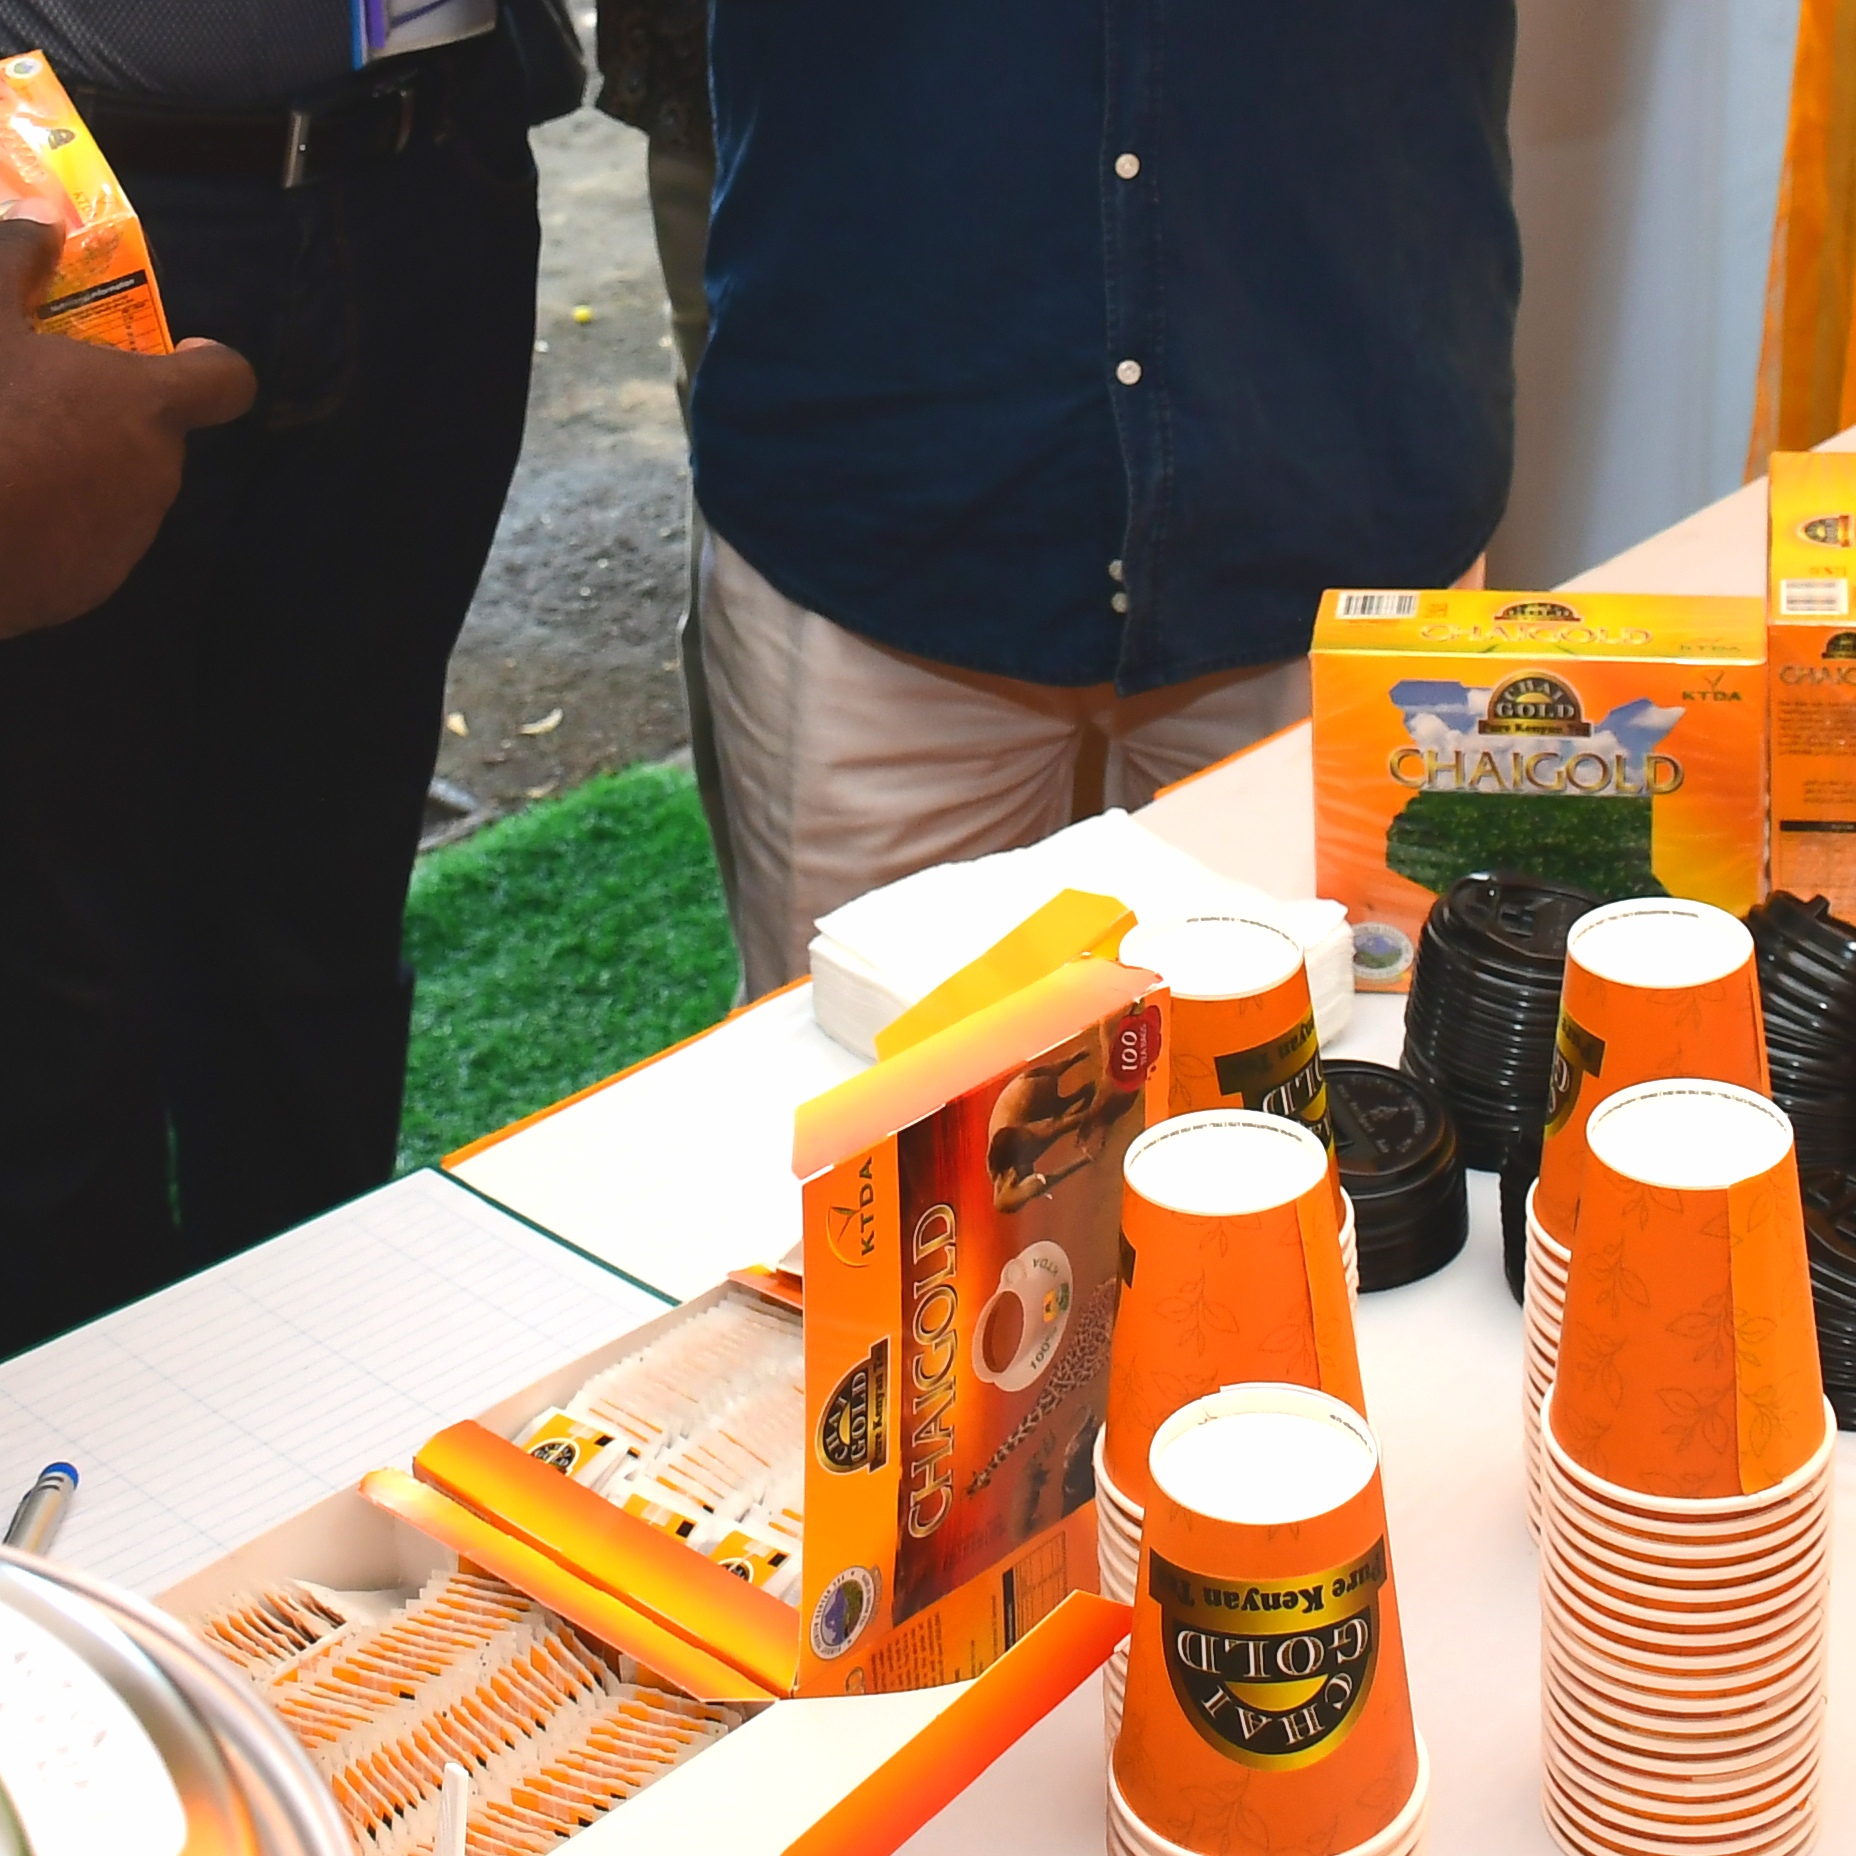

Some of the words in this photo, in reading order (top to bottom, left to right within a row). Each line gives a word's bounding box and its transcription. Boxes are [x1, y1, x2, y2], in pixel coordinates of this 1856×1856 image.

[1420, 622, 1653, 645] CHAIGOLD
[1495, 702, 1575, 719] GOLD
[1682, 690, 1743, 703] KTDA
[1388, 747, 1685, 795] CHAIGOLD
[1121, 1029, 1140, 1073] 100
[860, 1156, 876, 1257] KTDA
[907, 1202, 958, 1540] CHAIGOLD
[825, 1395, 849, 1463] CHAI
[850, 1371, 867, 1463] GOLD
[1203, 1582, 1325, 1614] Kenyan
[1176, 1615, 1371, 1679] GOLD
[1200, 1671, 1354, 1746] CHAI
